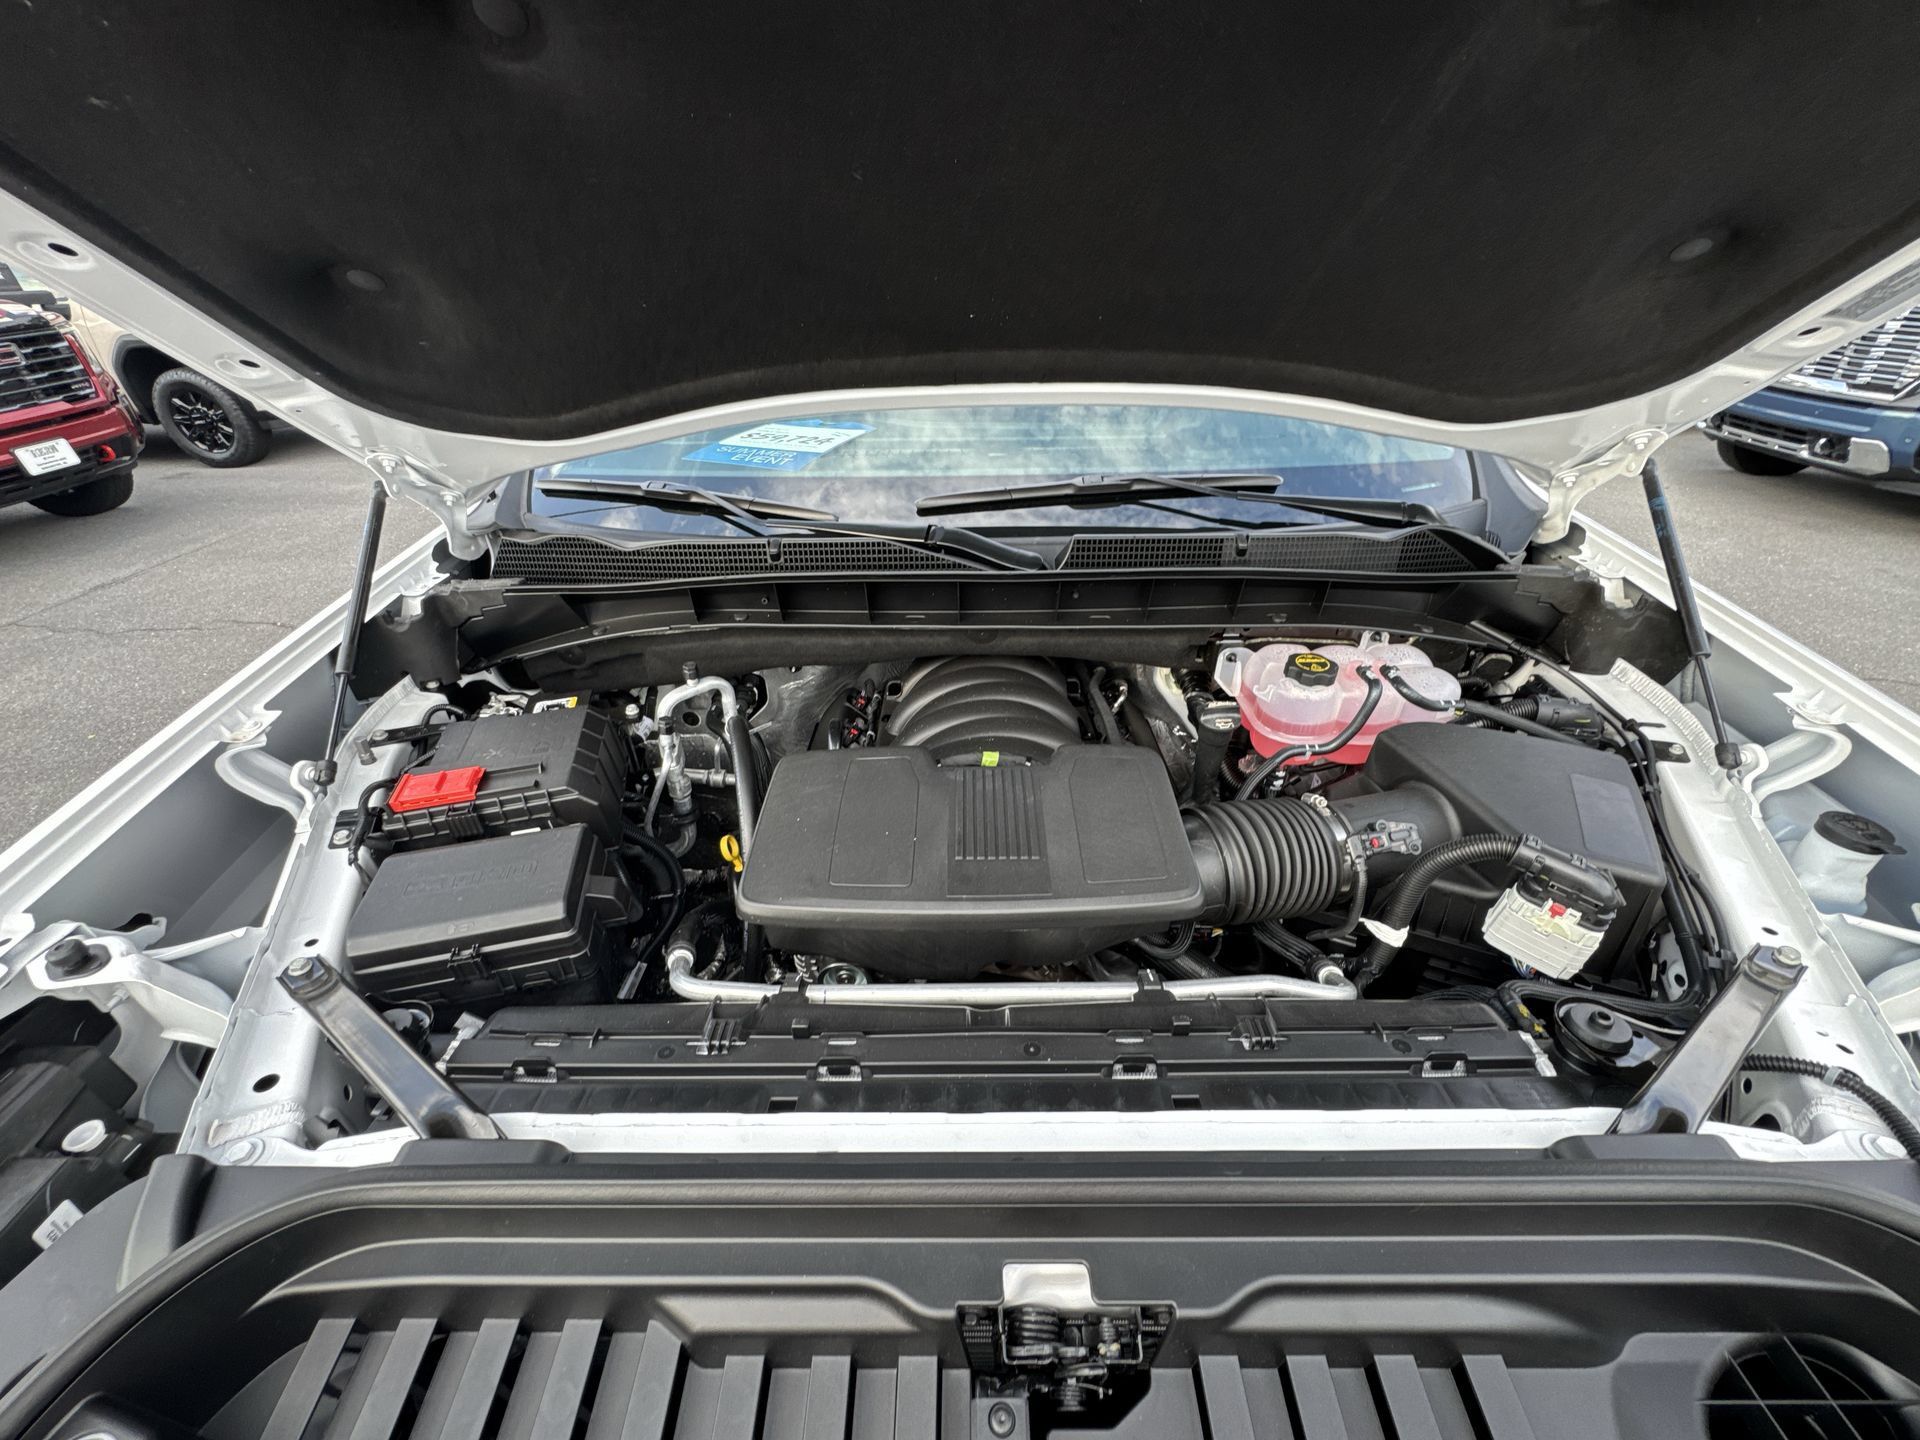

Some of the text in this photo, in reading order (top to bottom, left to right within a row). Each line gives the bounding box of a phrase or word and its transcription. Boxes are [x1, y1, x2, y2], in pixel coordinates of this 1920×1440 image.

[740, 433, 835, 446] $59,724
[716, 446, 797, 458] SUMMER
[730, 453, 792, 466] EVENT
